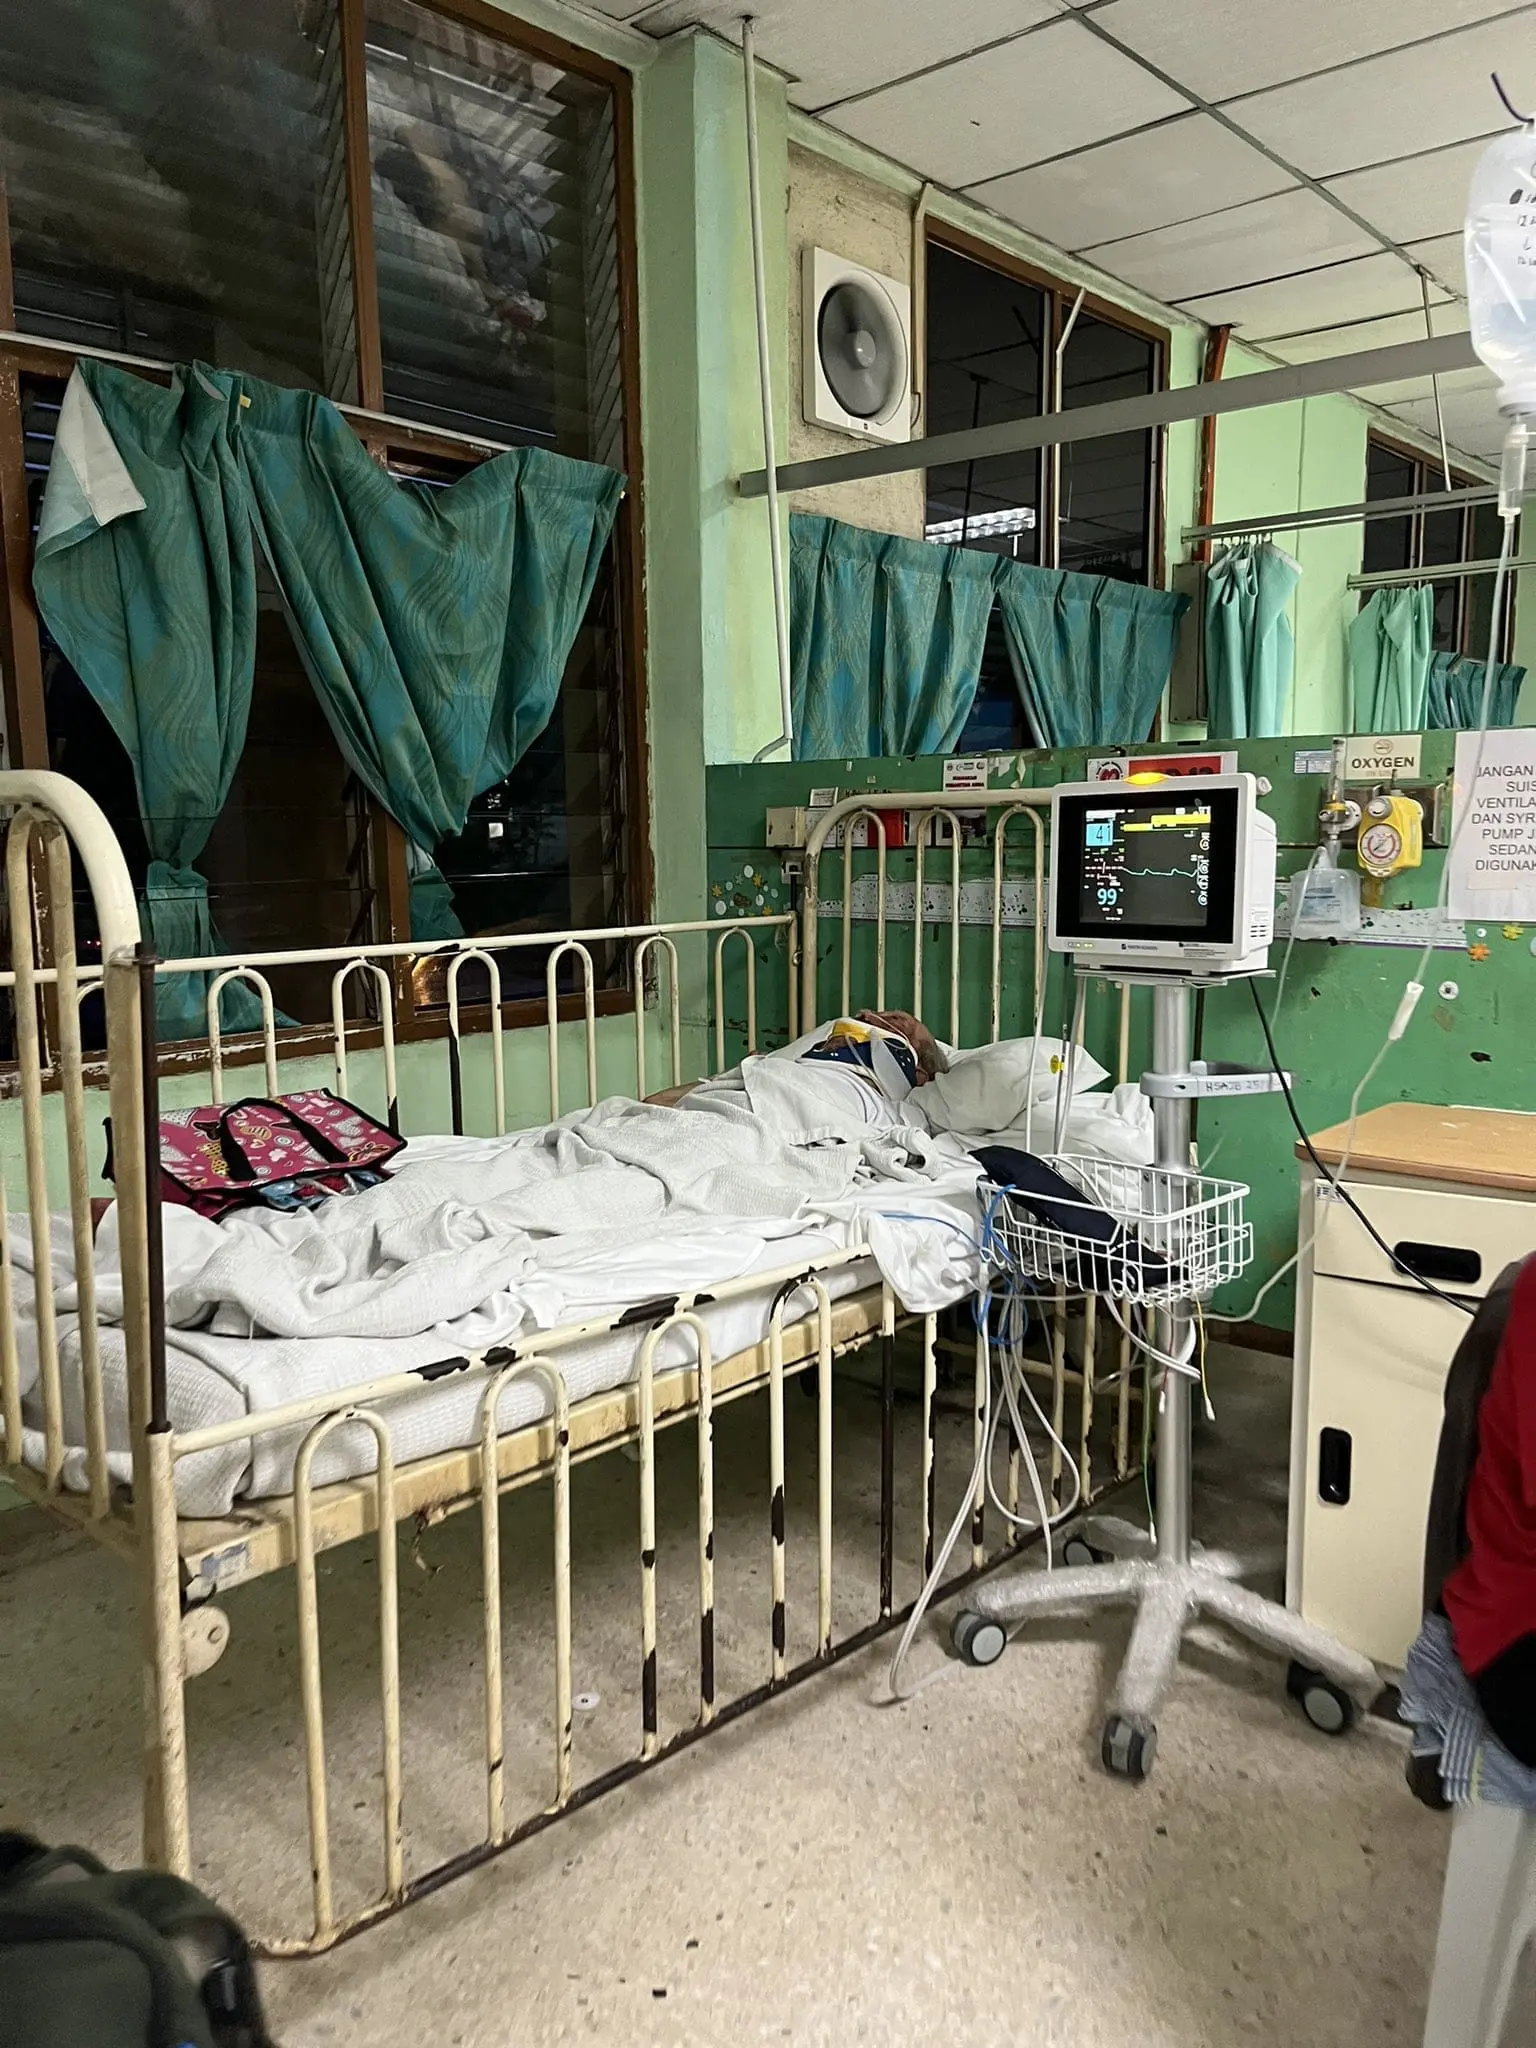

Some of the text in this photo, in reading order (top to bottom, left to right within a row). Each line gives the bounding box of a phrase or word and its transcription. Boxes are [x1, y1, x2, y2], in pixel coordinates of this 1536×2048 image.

[1351, 756, 1415, 769] OXYGEN
[1476, 765, 1534, 778] JANGAN
[1476, 797, 1536, 809] VENTILA
[1471, 812, 1536, 824] DAN SYR
[1482, 828, 1524, 840] PUMP
[1097, 888, 1118, 906] 99
